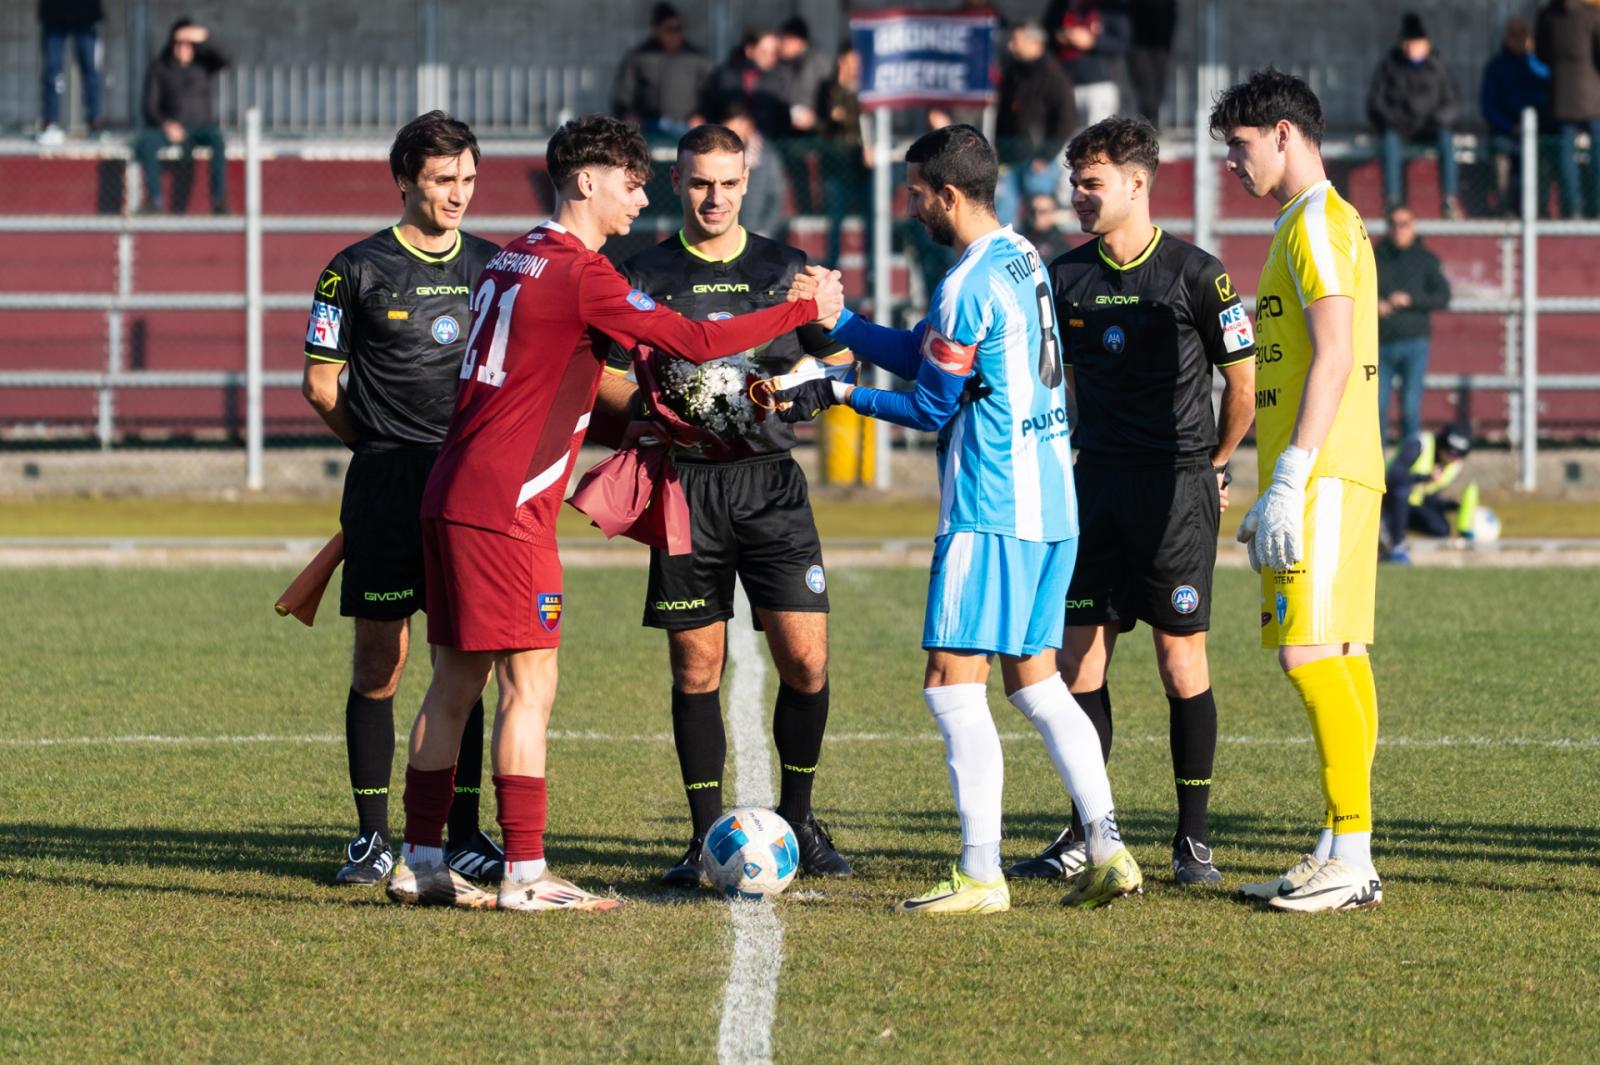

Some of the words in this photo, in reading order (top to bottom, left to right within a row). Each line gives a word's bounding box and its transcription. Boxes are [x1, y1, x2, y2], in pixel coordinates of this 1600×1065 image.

[416, 285, 469, 296] GIVOVA
[692, 284, 749, 293] GIVOVA
[1095, 295, 1140, 305] GIVOVA
[459, 278, 522, 388] 21
[1036, 281, 1063, 390] 8
[364, 589, 413, 601] GIVOVA
[1065, 599, 1094, 609] OVA
